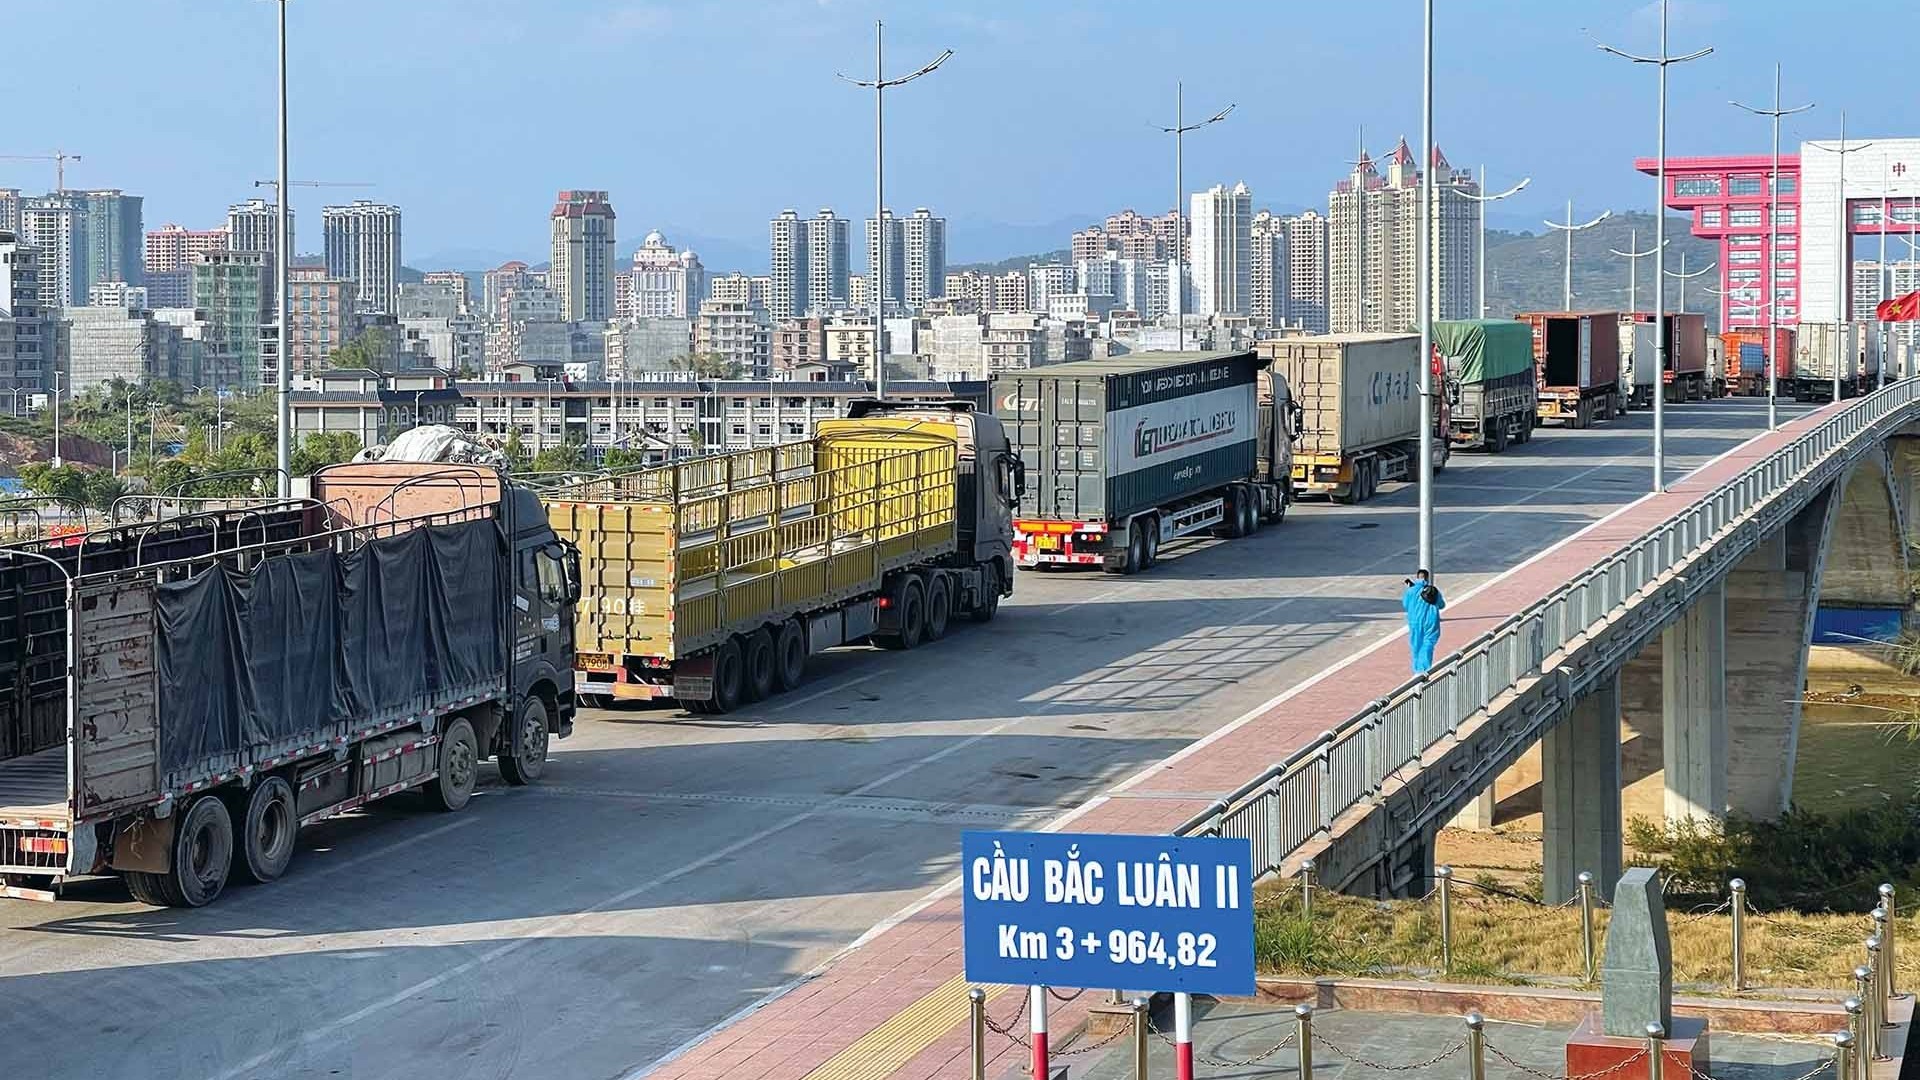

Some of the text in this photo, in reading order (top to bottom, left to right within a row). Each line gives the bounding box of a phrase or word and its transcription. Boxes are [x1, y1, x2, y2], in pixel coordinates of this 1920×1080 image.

[1892, 162, 1906, 177] 中
[972, 841, 1239, 909] CẦU BẮC LUÂN II
[998, 924, 1048, 960] Km
